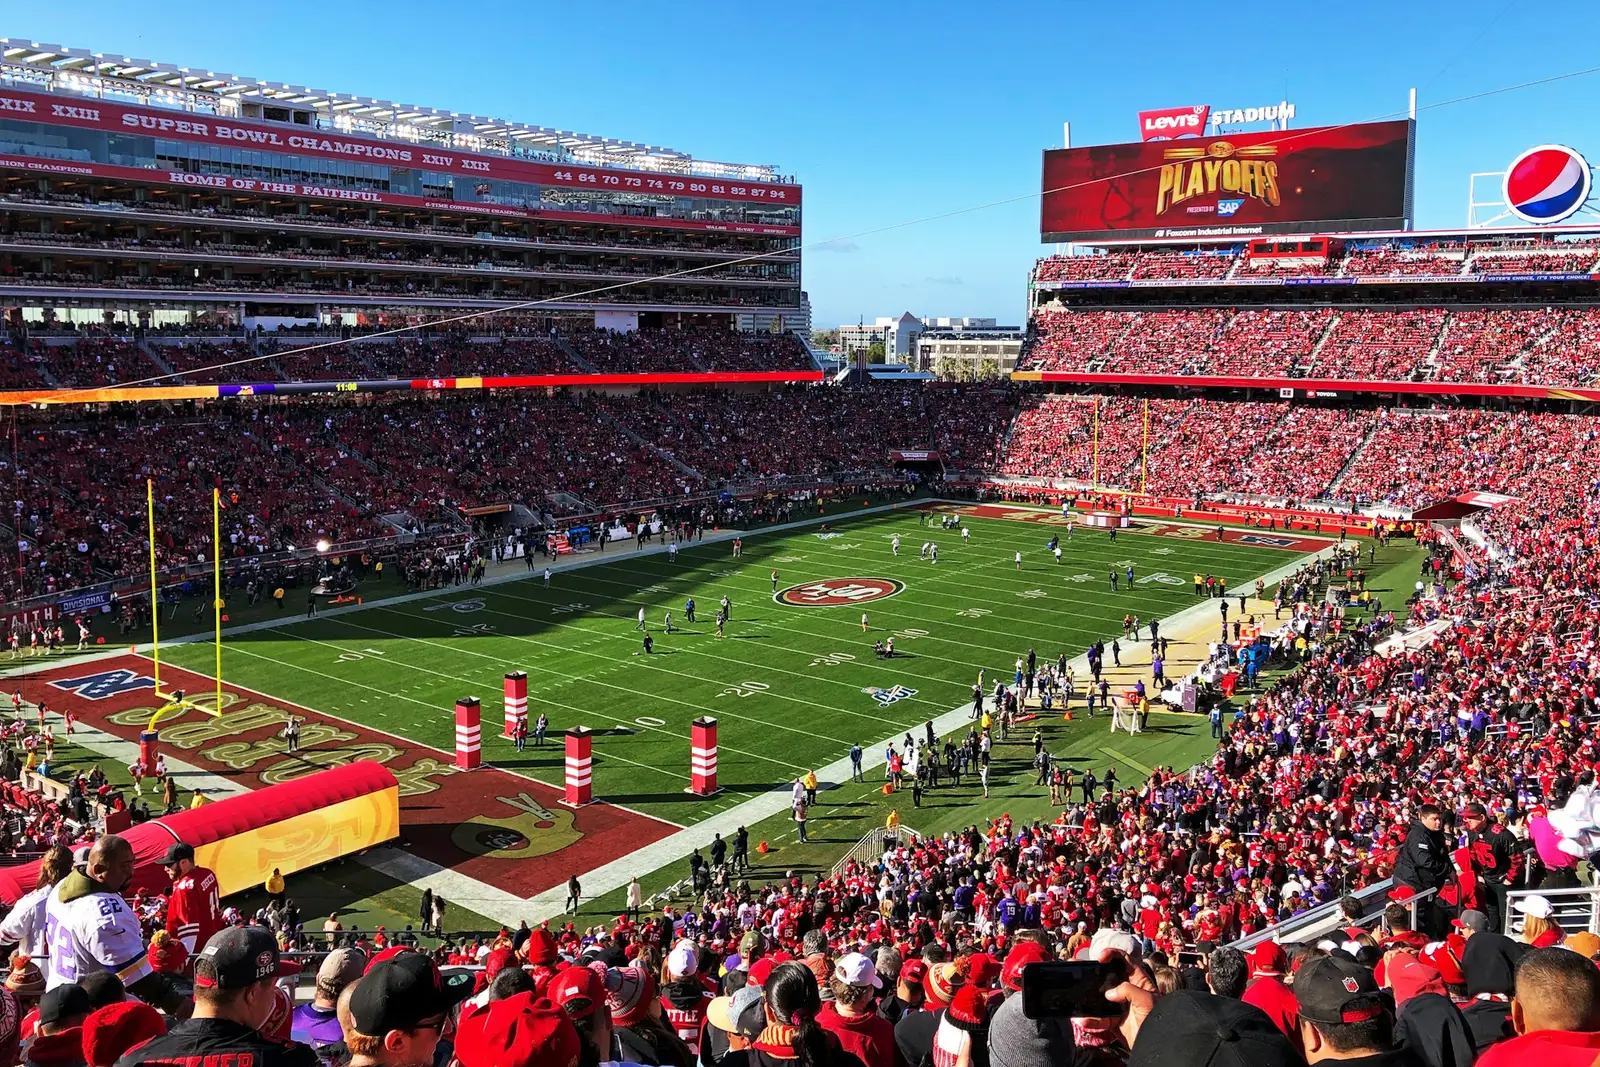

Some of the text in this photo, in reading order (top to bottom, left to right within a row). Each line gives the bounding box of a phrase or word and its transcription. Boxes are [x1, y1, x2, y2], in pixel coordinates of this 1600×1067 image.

[52, 104, 100, 121] XXIII
[1212, 104, 1296, 125] STADIUM
[122, 113, 491, 171] SUPER BOWL CHAMPIONS XXIV XXIX
[28, 162, 93, 174] CHAMPIONS
[169, 172, 382, 202] HOME OF THE FAITHFUL
[554, 171, 785, 198] 44 64 70 73 74 79 80 81 82 87 94
[1156, 160, 1280, 215] PLAYOFFS
[449, 204, 491, 213] CONFERENCE
[491, 208, 528, 217] CHAMPIONS
[1218, 203, 1240, 214] SAP
[1165, 229, 1197, 237] Foxconn
[1198, 228, 1232, 236] Industrial
[1233, 226, 1263, 235] Internet
[63, 595, 105, 611] DIVISIONAL
[97, 898, 122, 917] 22
[1007, 907, 1016, 916] 19
[255, 962, 275, 978] 1946
